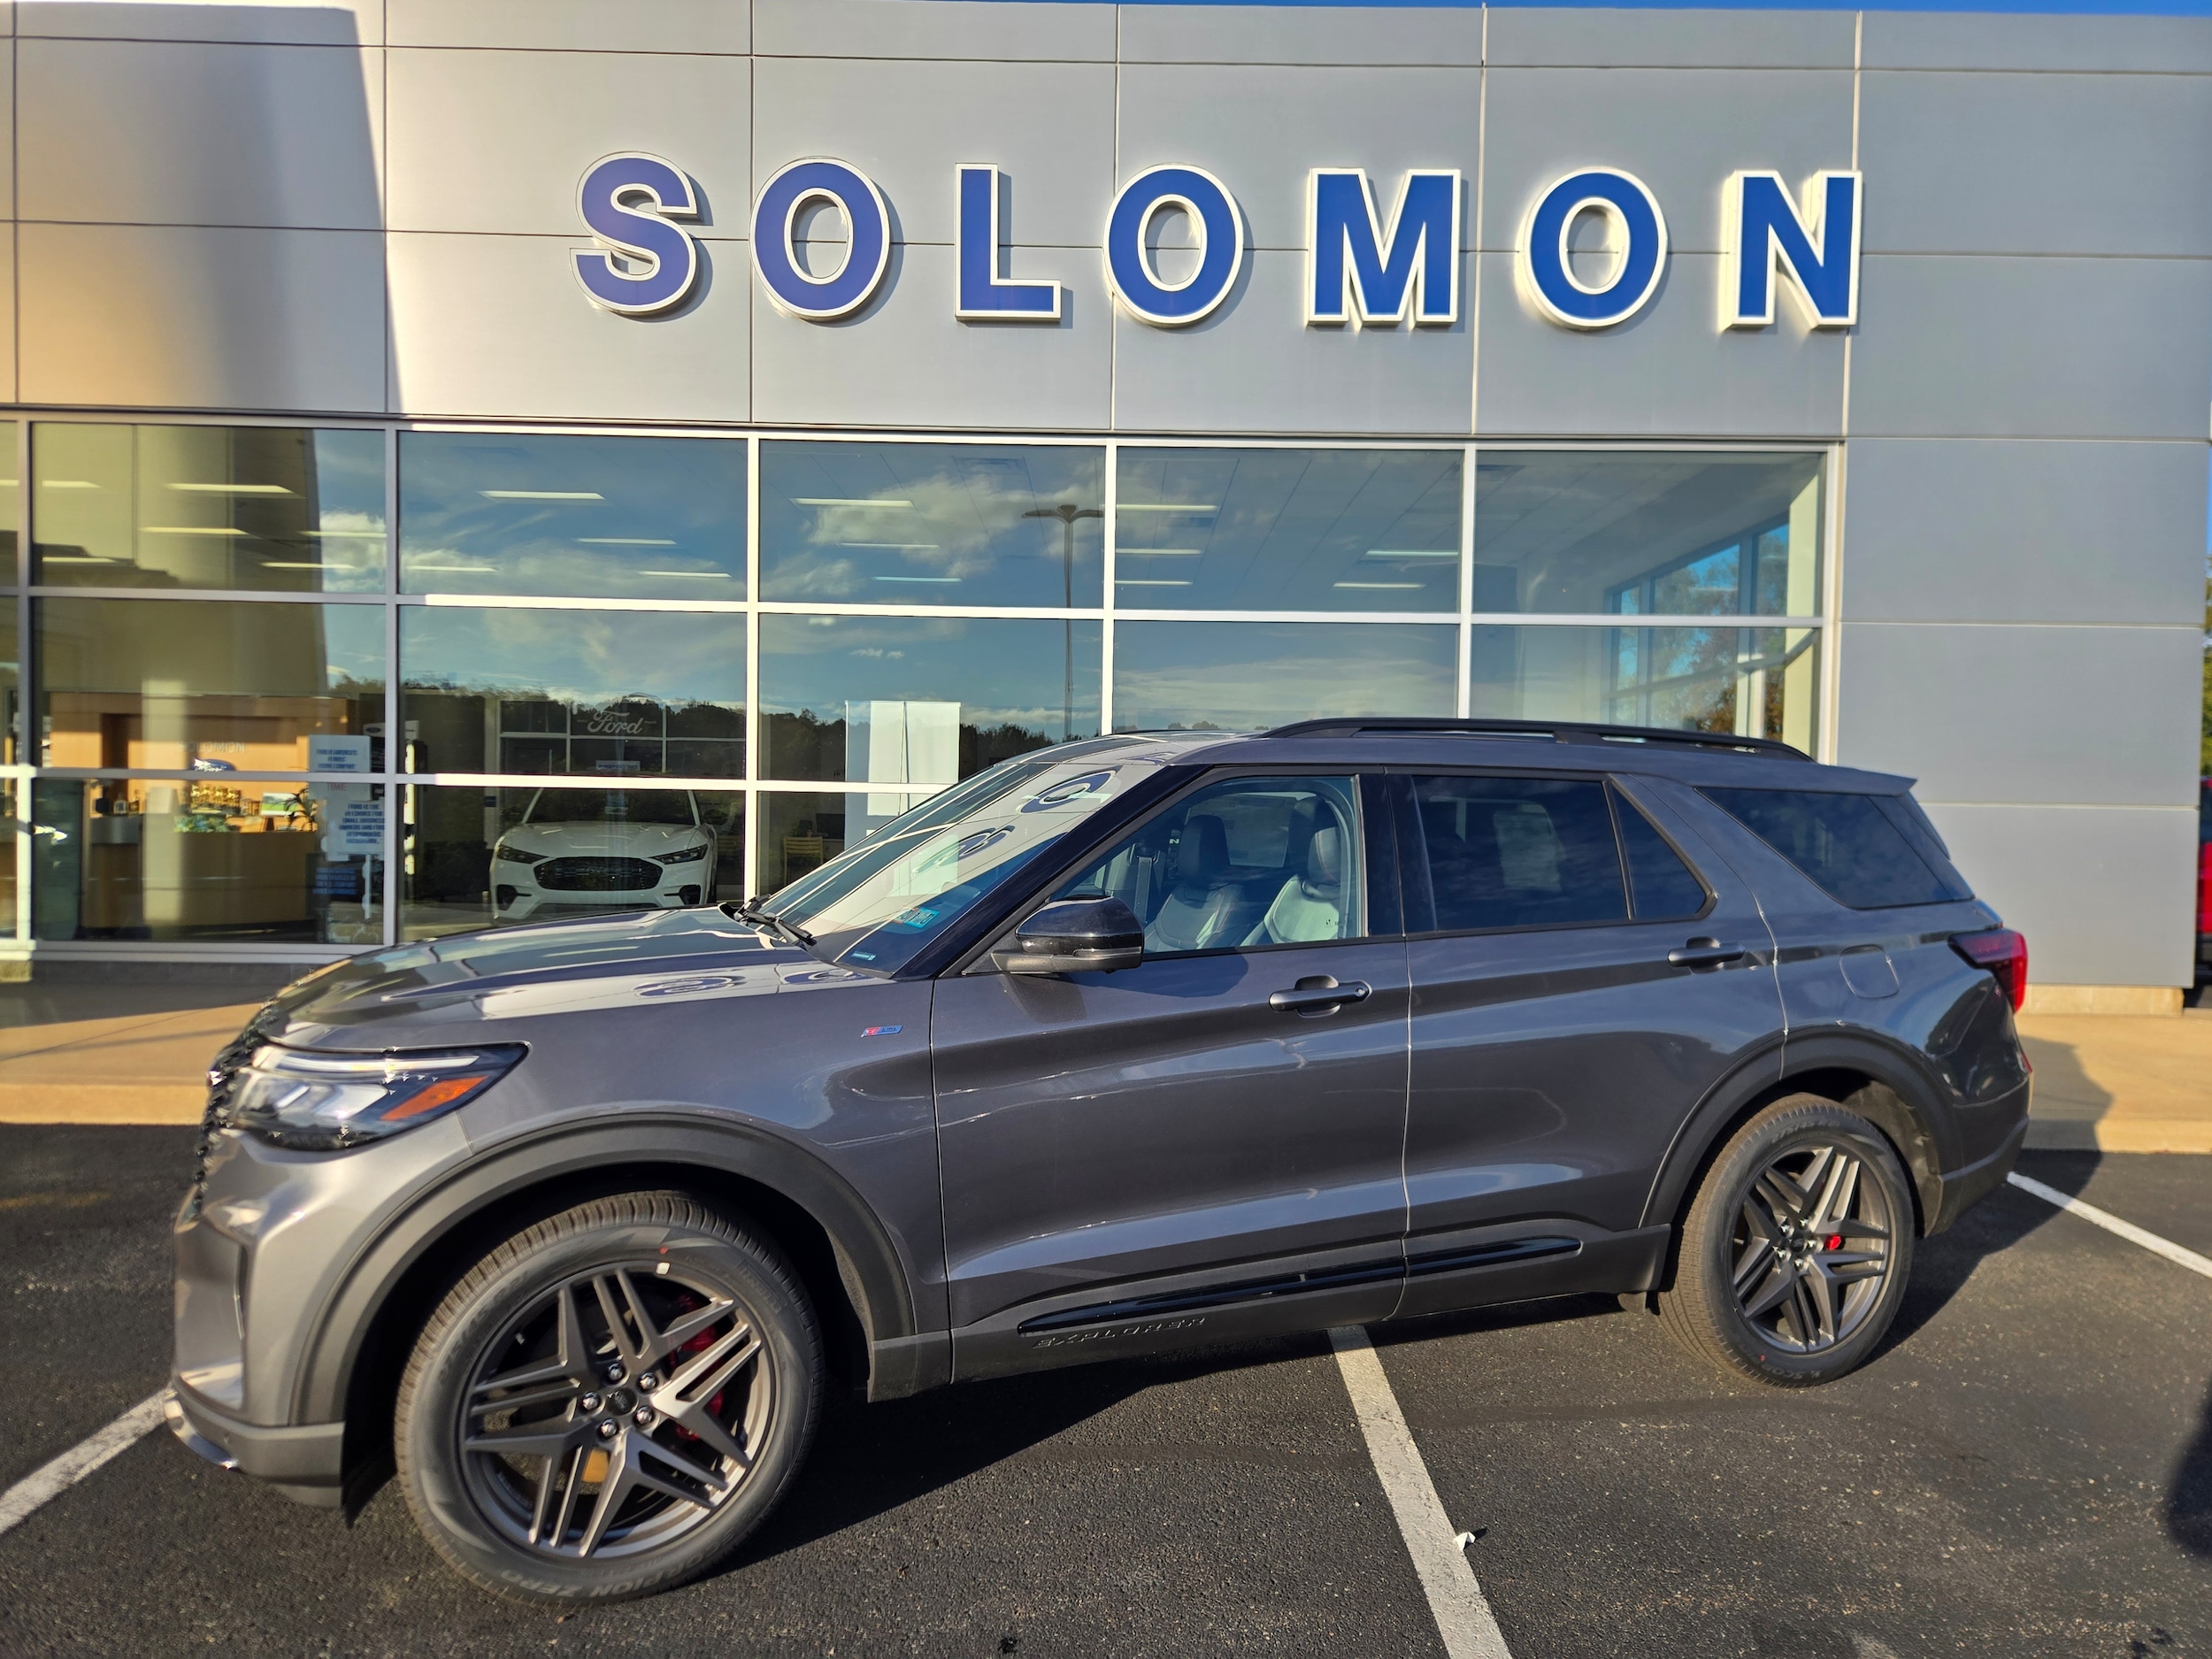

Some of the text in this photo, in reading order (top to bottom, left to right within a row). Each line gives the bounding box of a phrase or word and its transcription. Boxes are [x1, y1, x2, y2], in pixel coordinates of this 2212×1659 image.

[571, 152, 1863, 331] SOLOMON
[588, 710, 644, 734] Ford
[1033, 1317, 1206, 1349] EXPLORER
